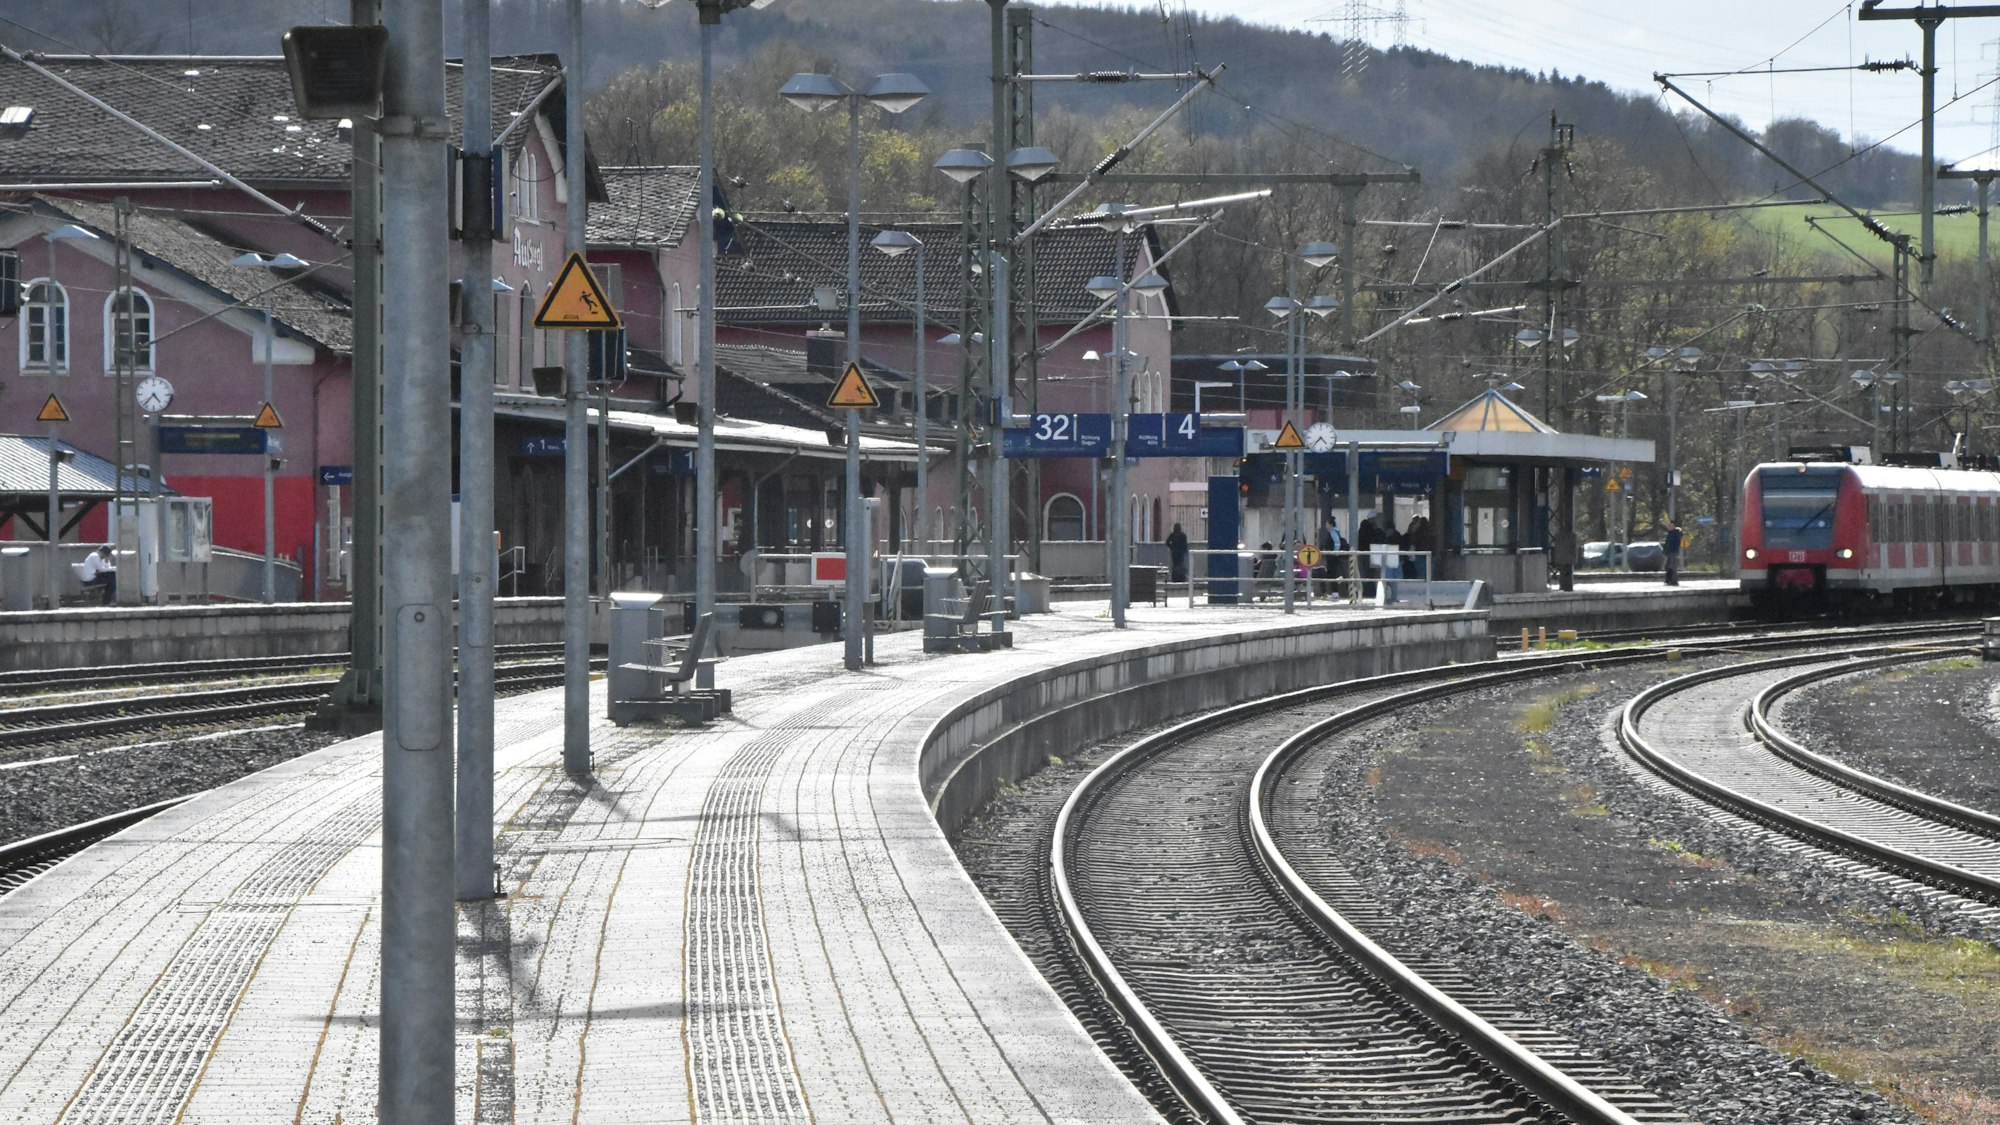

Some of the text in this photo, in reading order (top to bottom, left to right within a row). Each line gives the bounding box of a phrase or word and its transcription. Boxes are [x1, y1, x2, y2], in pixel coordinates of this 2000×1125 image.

[1034, 414, 1069, 440] 32
[1178, 413, 1196, 439] 4
[1789, 551, 1805, 562] DB
